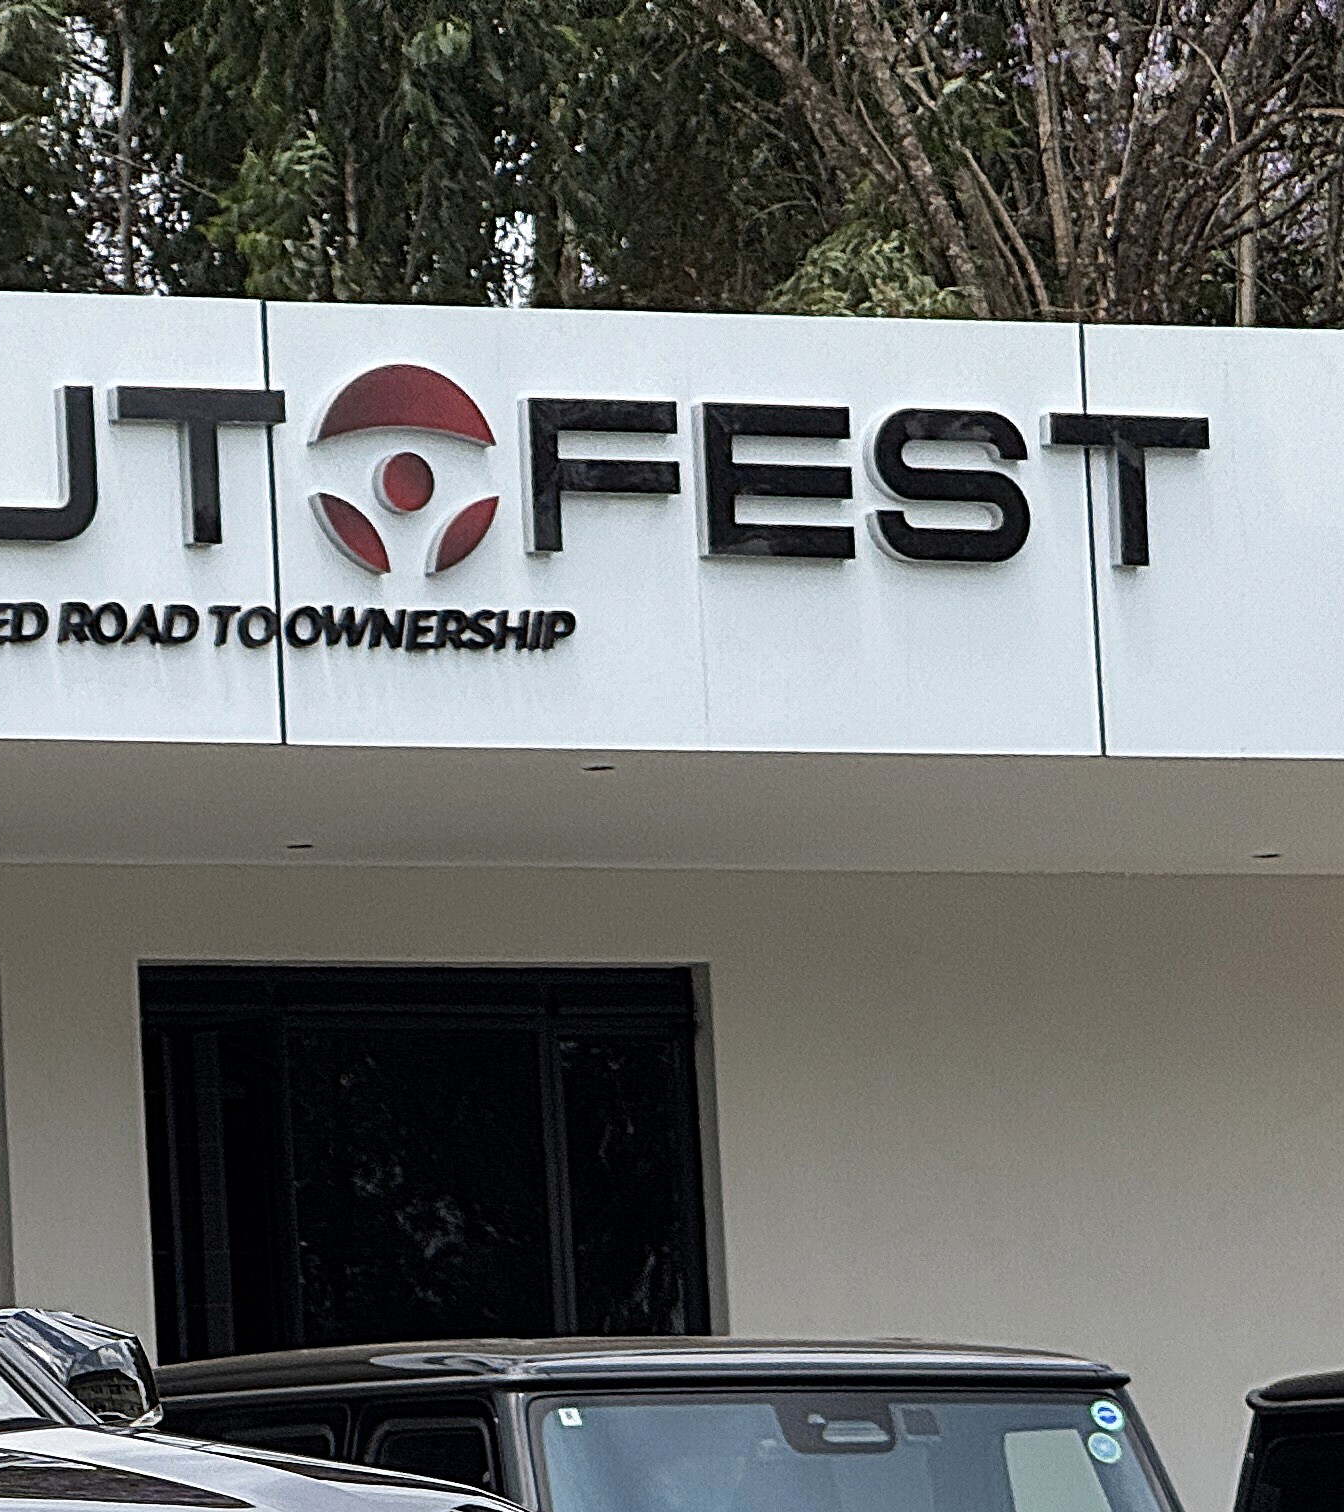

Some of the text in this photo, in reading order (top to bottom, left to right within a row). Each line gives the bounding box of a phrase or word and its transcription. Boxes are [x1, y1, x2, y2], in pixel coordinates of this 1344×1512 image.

[56, 601, 201, 646] ROAD
[208, 604, 278, 650] TO
[285, 604, 577, 652] OWNERSHIP
